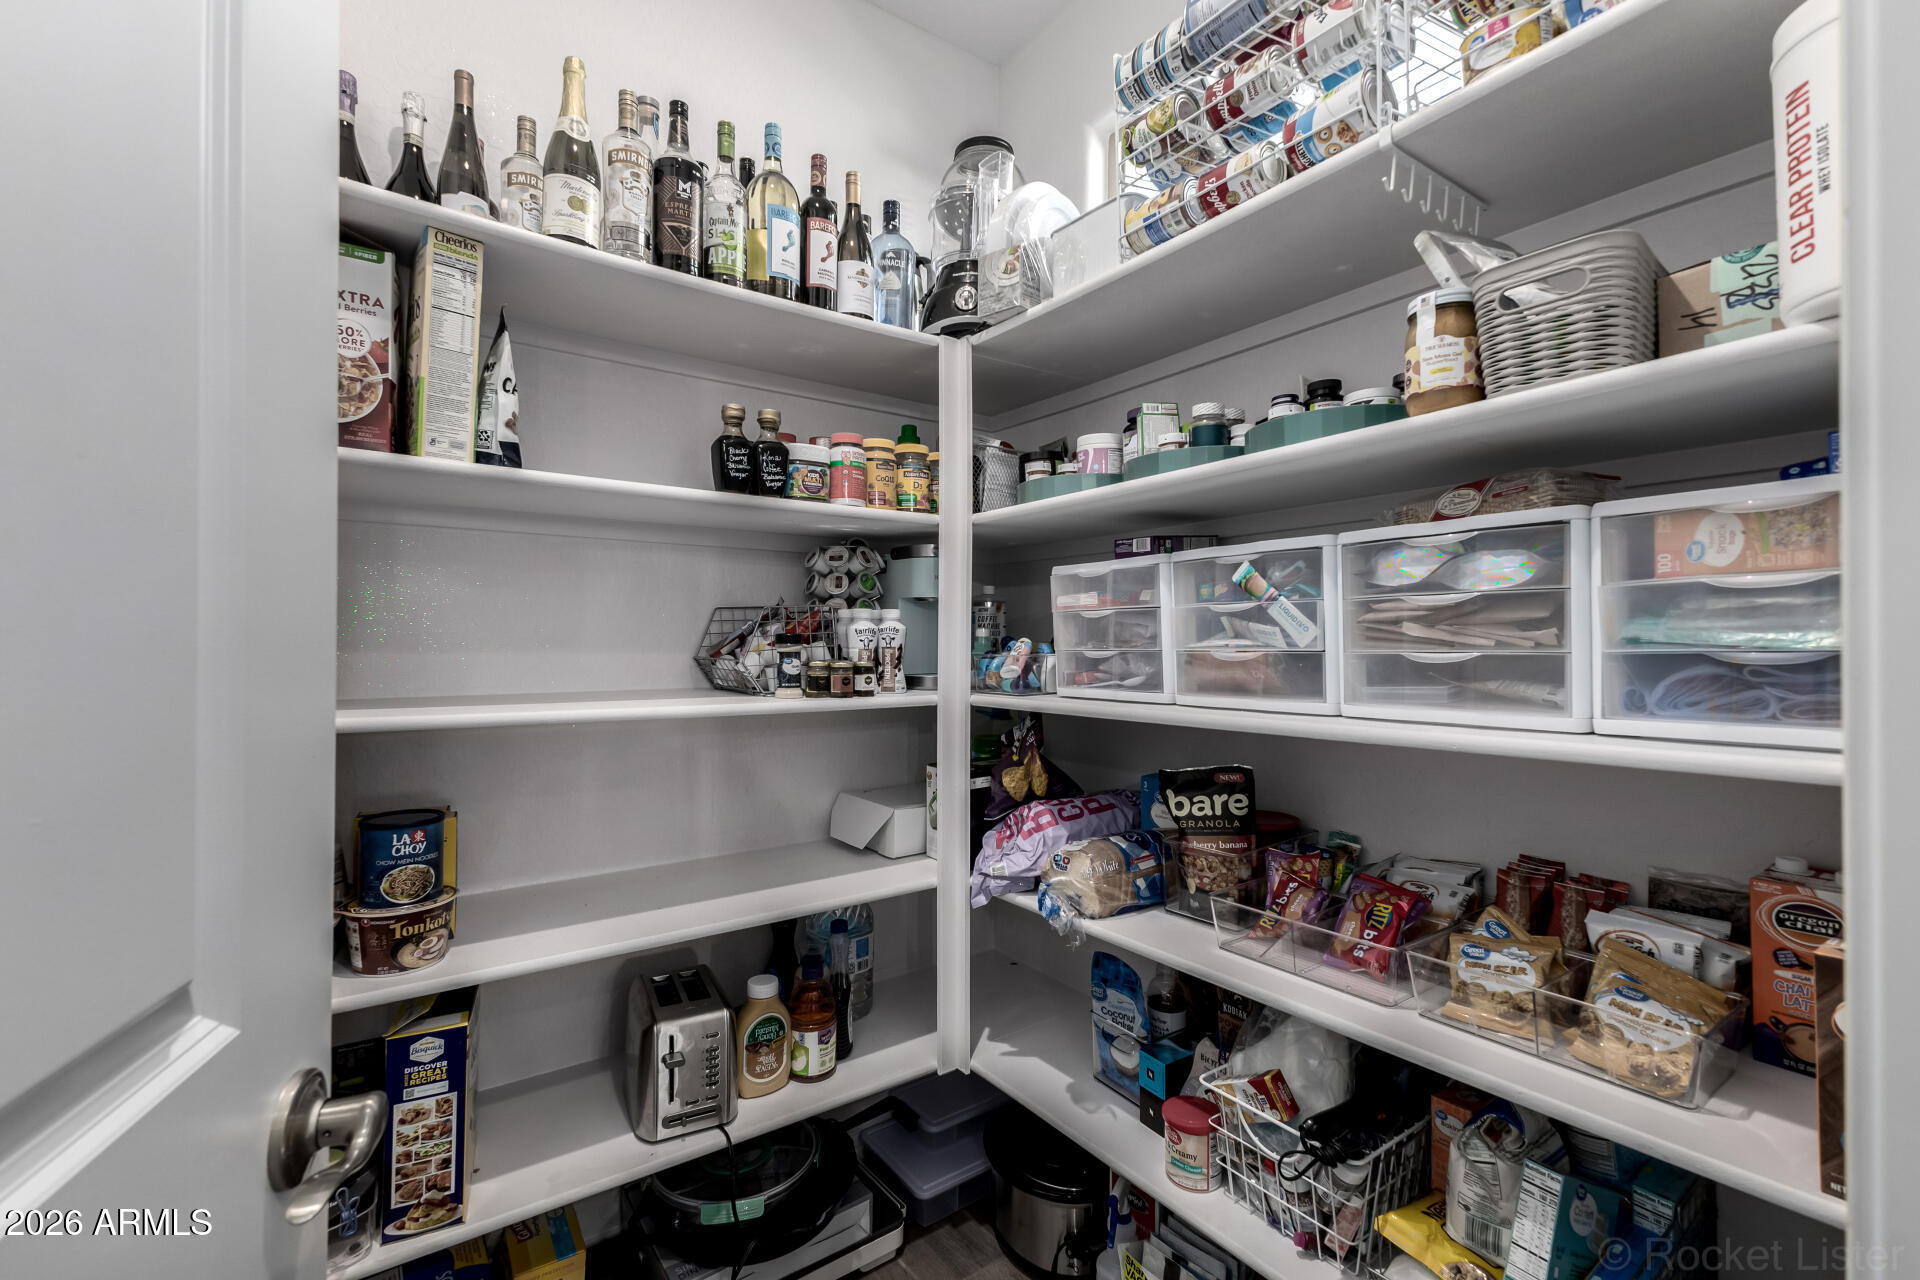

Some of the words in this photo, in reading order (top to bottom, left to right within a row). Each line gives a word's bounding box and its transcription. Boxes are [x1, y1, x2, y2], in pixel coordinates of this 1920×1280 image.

[1786, 80, 1812, 187] PROTEIN
[1816, 122, 1830, 166] ISOLATE
[611, 150, 653, 171] SMIRNO
[511, 174, 543, 190] SMIRN
[1818, 163, 1831, 195] WHEY
[667, 208, 692, 218] MARTI
[810, 221, 837, 235] BAREFO
[1789, 183, 1816, 264] CLEAR
[434, 230, 478, 252] Cheerios
[345, 303, 377, 316] Berries
[338, 337, 366, 347] ORE
[1657, 553, 1671, 574] 100
[1165, 789, 1249, 816] bare
[1179, 820, 1241, 828] GRANOLA
[392, 833, 411, 846] LA
[1219, 841, 1248, 849] banana
[391, 841, 427, 857] CHOY
[1368, 902, 1393, 930] RITZ
[1778, 911, 1840, 930] oregon
[389, 911, 451, 939] Tonkot
[1784, 919, 1836, 936] chai
[1774, 979, 1811, 998] CHAI
[1222, 1002, 1248, 1019] KODIAK
[1784, 994, 1815, 1012] LAT
[1101, 1006, 1136, 1023] Coconut
[411, 1043, 444, 1056] Bisquick
[404, 1060, 448, 1074] DISCOVER
[411, 1066, 448, 1080] GREAT
[409, 1073, 447, 1086] RECIPES
[1171, 1145, 1198, 1162] Creamy
